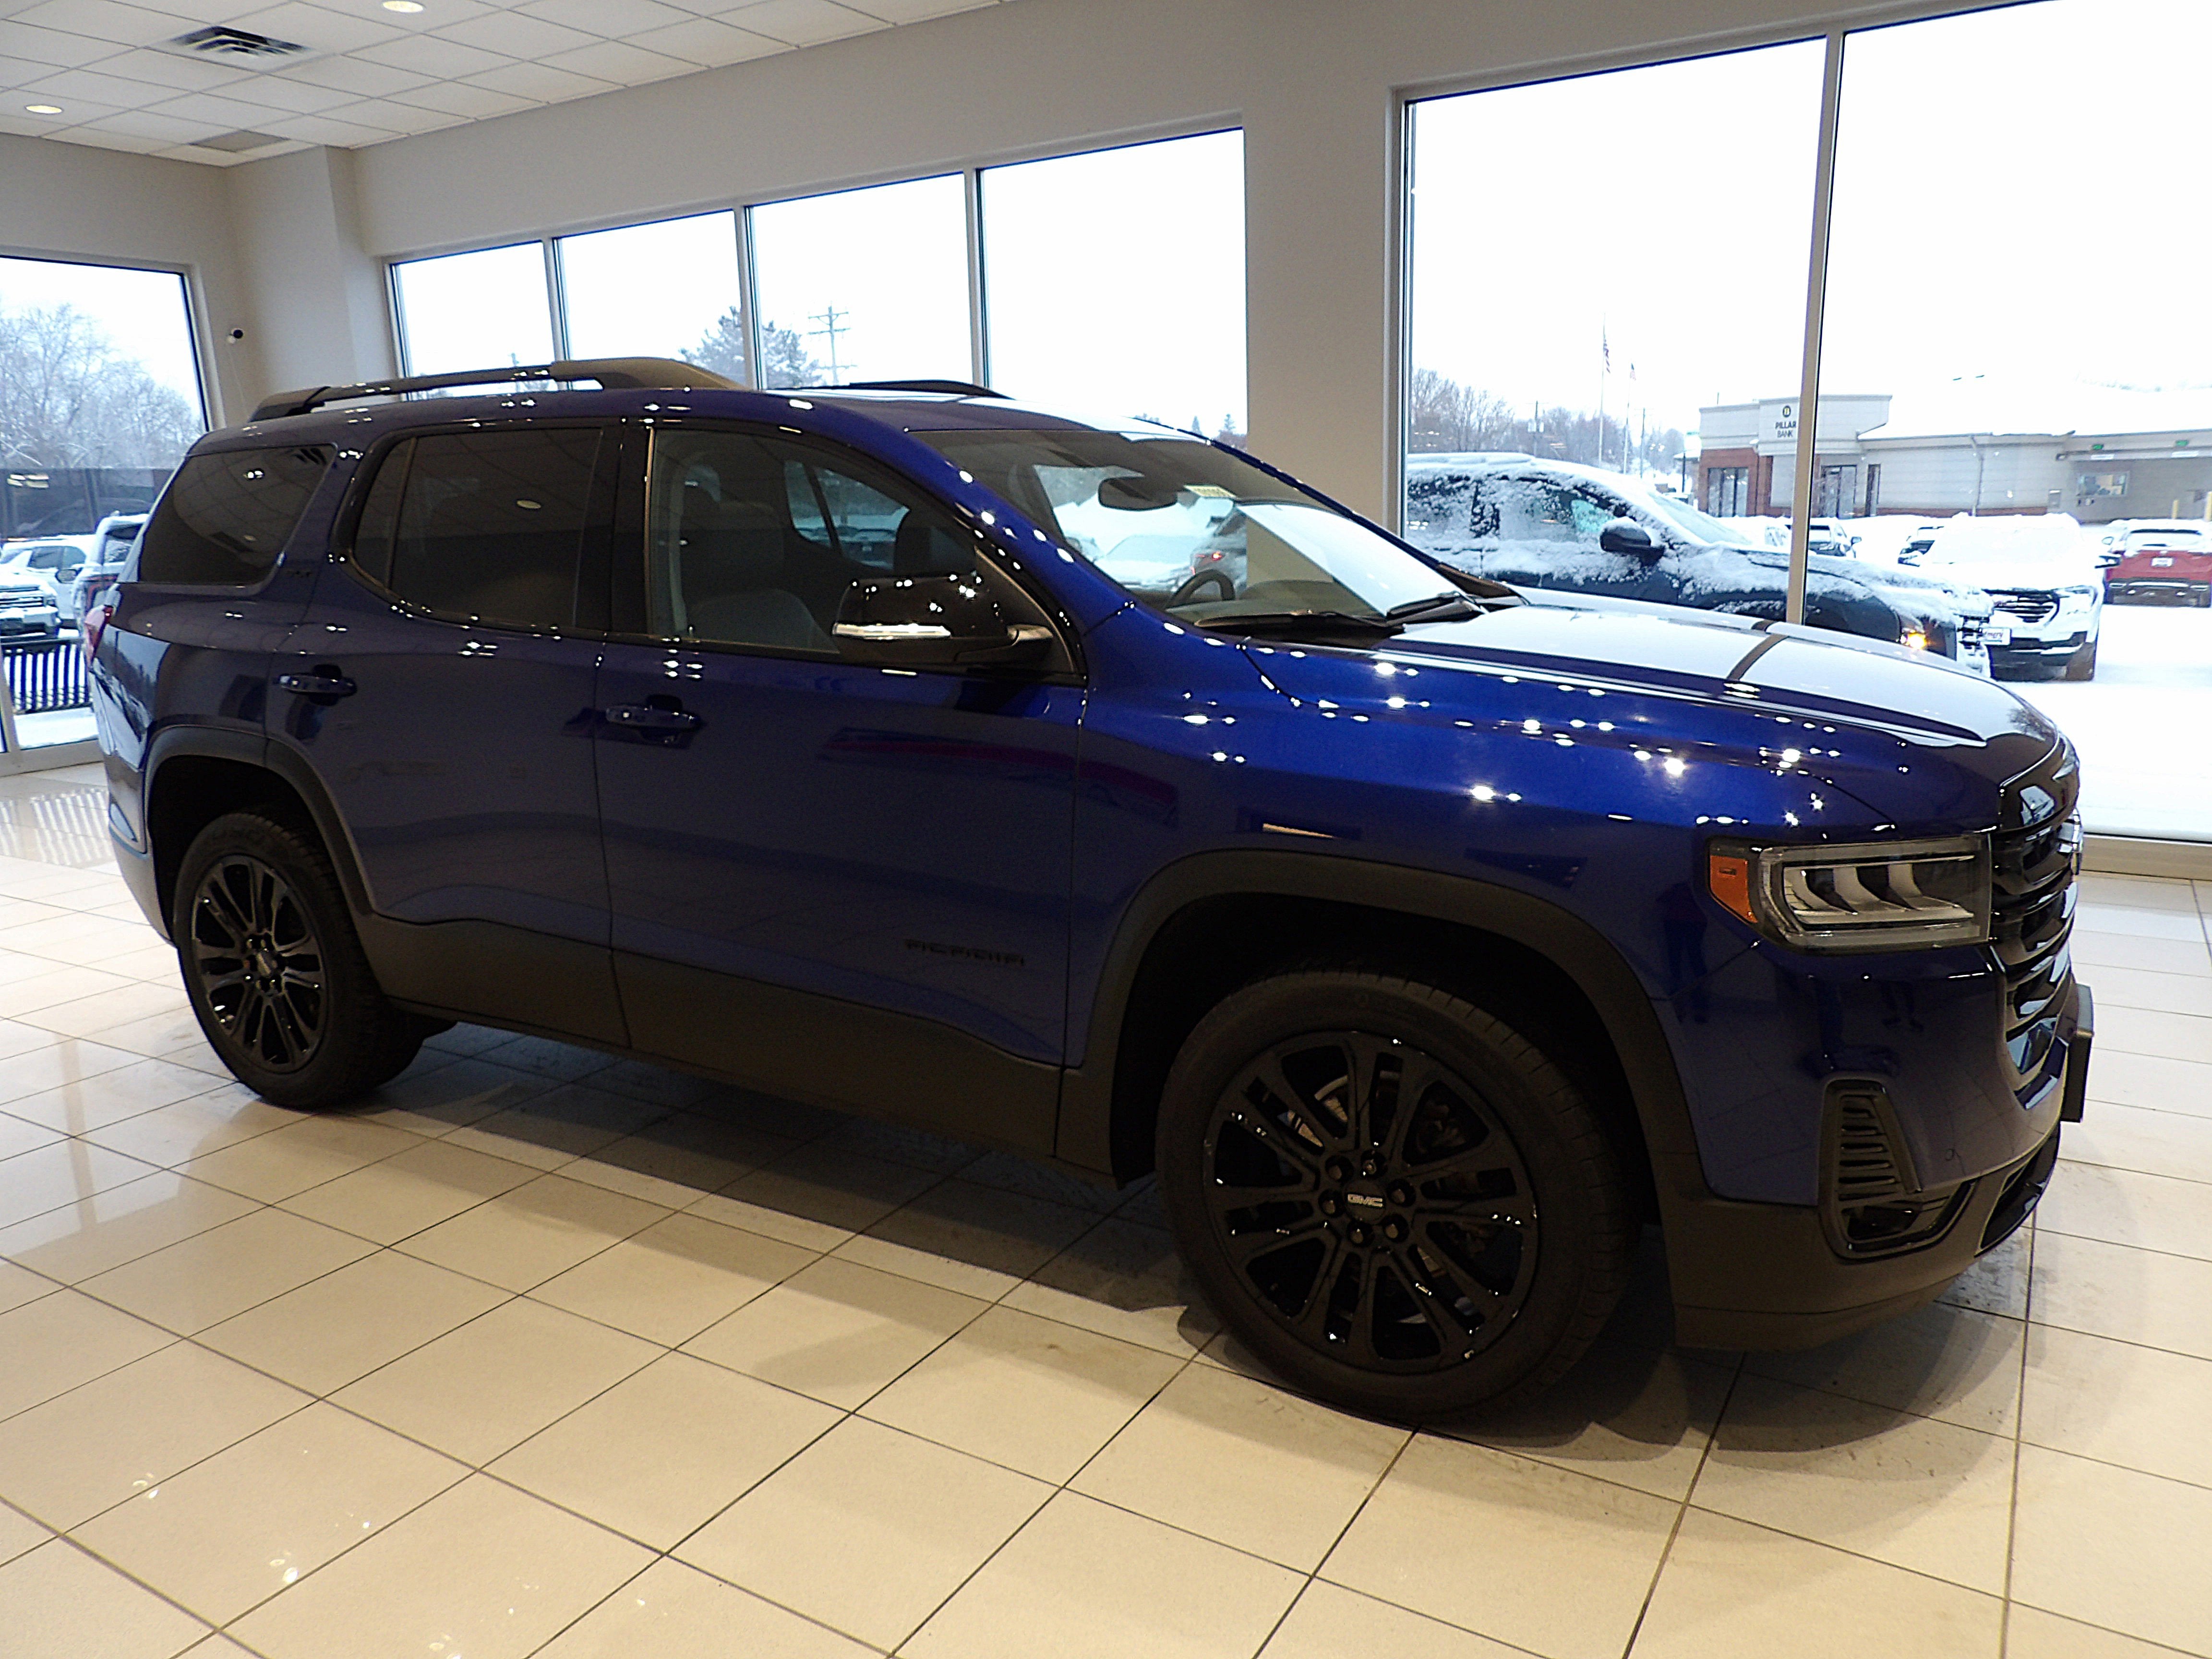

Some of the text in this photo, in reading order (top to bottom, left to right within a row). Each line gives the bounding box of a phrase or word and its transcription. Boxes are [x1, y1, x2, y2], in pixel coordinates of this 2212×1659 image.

[1775, 421, 1797, 429] PILLAR
[1777, 430, 1793, 438] BANK
[903, 939, 1025, 966] ACADIA
[1347, 1193, 1384, 1208] GMC
